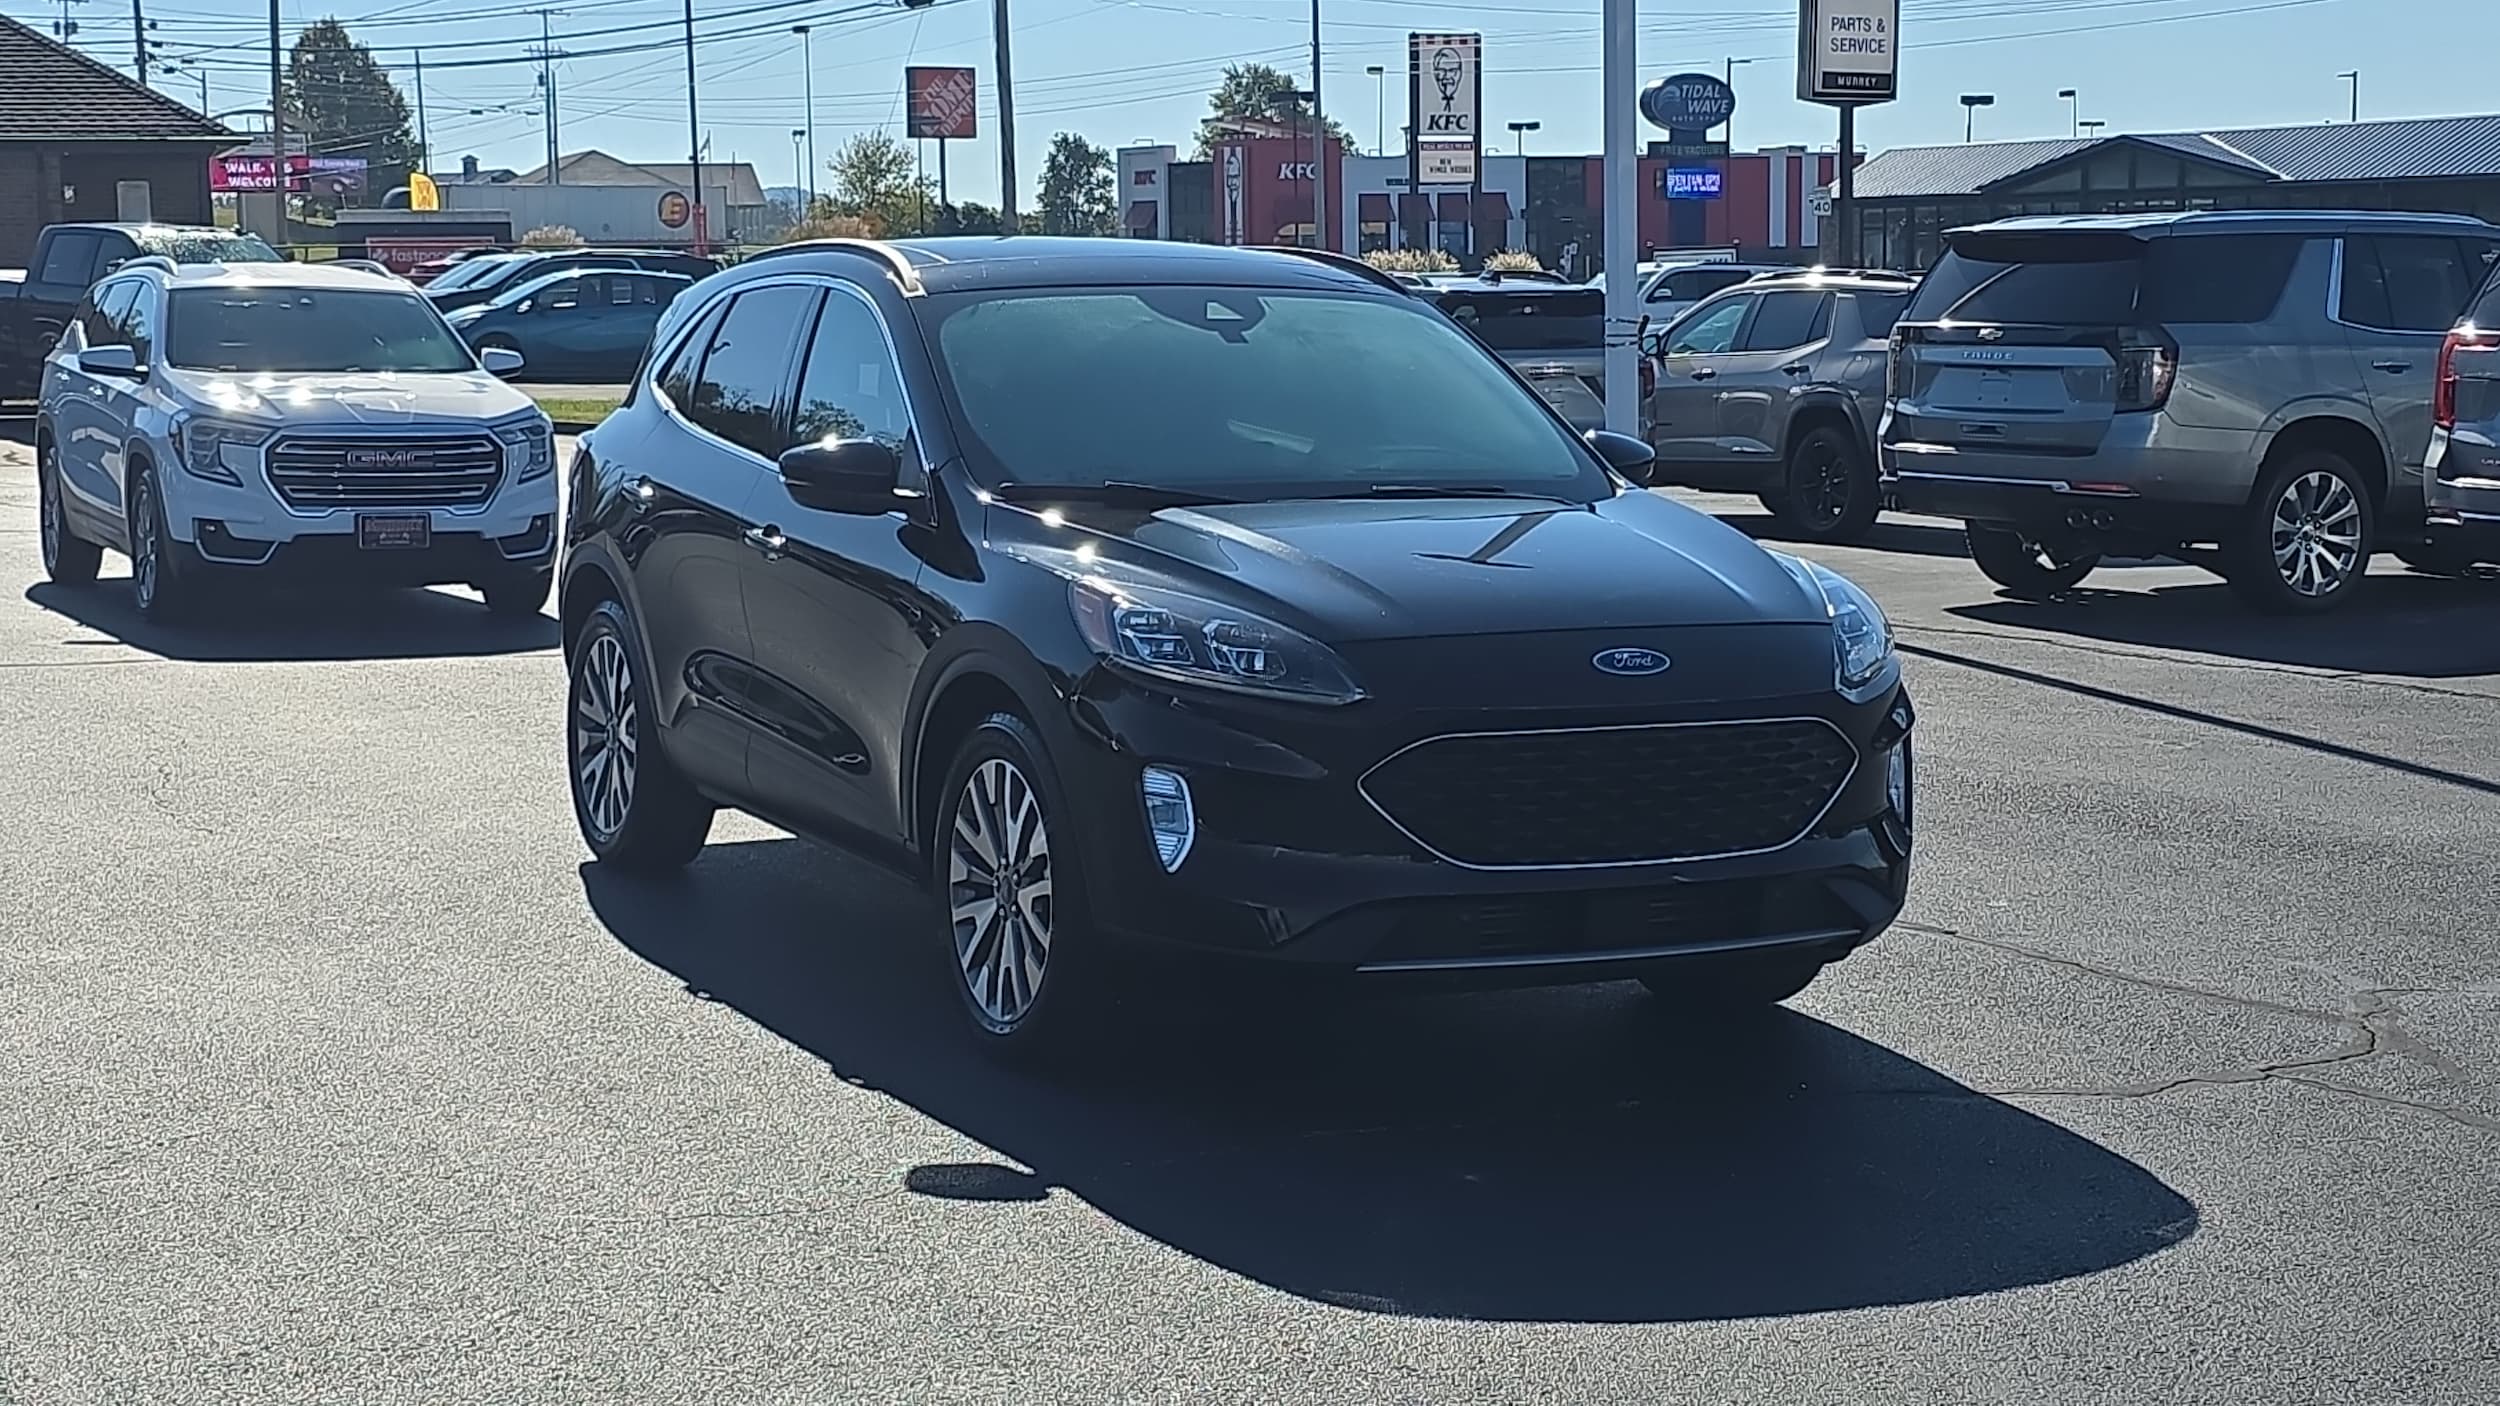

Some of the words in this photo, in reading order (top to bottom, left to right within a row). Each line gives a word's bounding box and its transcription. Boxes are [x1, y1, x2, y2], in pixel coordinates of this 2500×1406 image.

[1831, 16, 1872, 32] PARTS
[1876, 18, 1886, 33] &
[1830, 37, 1886, 53] SERVICE
[923, 74, 946, 102] THE
[1682, 84, 1721, 98] TIDAL
[1687, 99, 1729, 113] WAVE
[940, 94, 974, 136] DEPOT
[1427, 114, 1469, 130] KFC
[225, 162, 266, 174] WALK-
[1278, 163, 1316, 180] KFC
[1814, 201, 1831, 212] 40
[392, 249, 446, 263] fastpac
[1962, 351, 2015, 360] TAHOE
[347, 450, 434, 468] GMC
[1613, 652, 1655, 668] Ford
